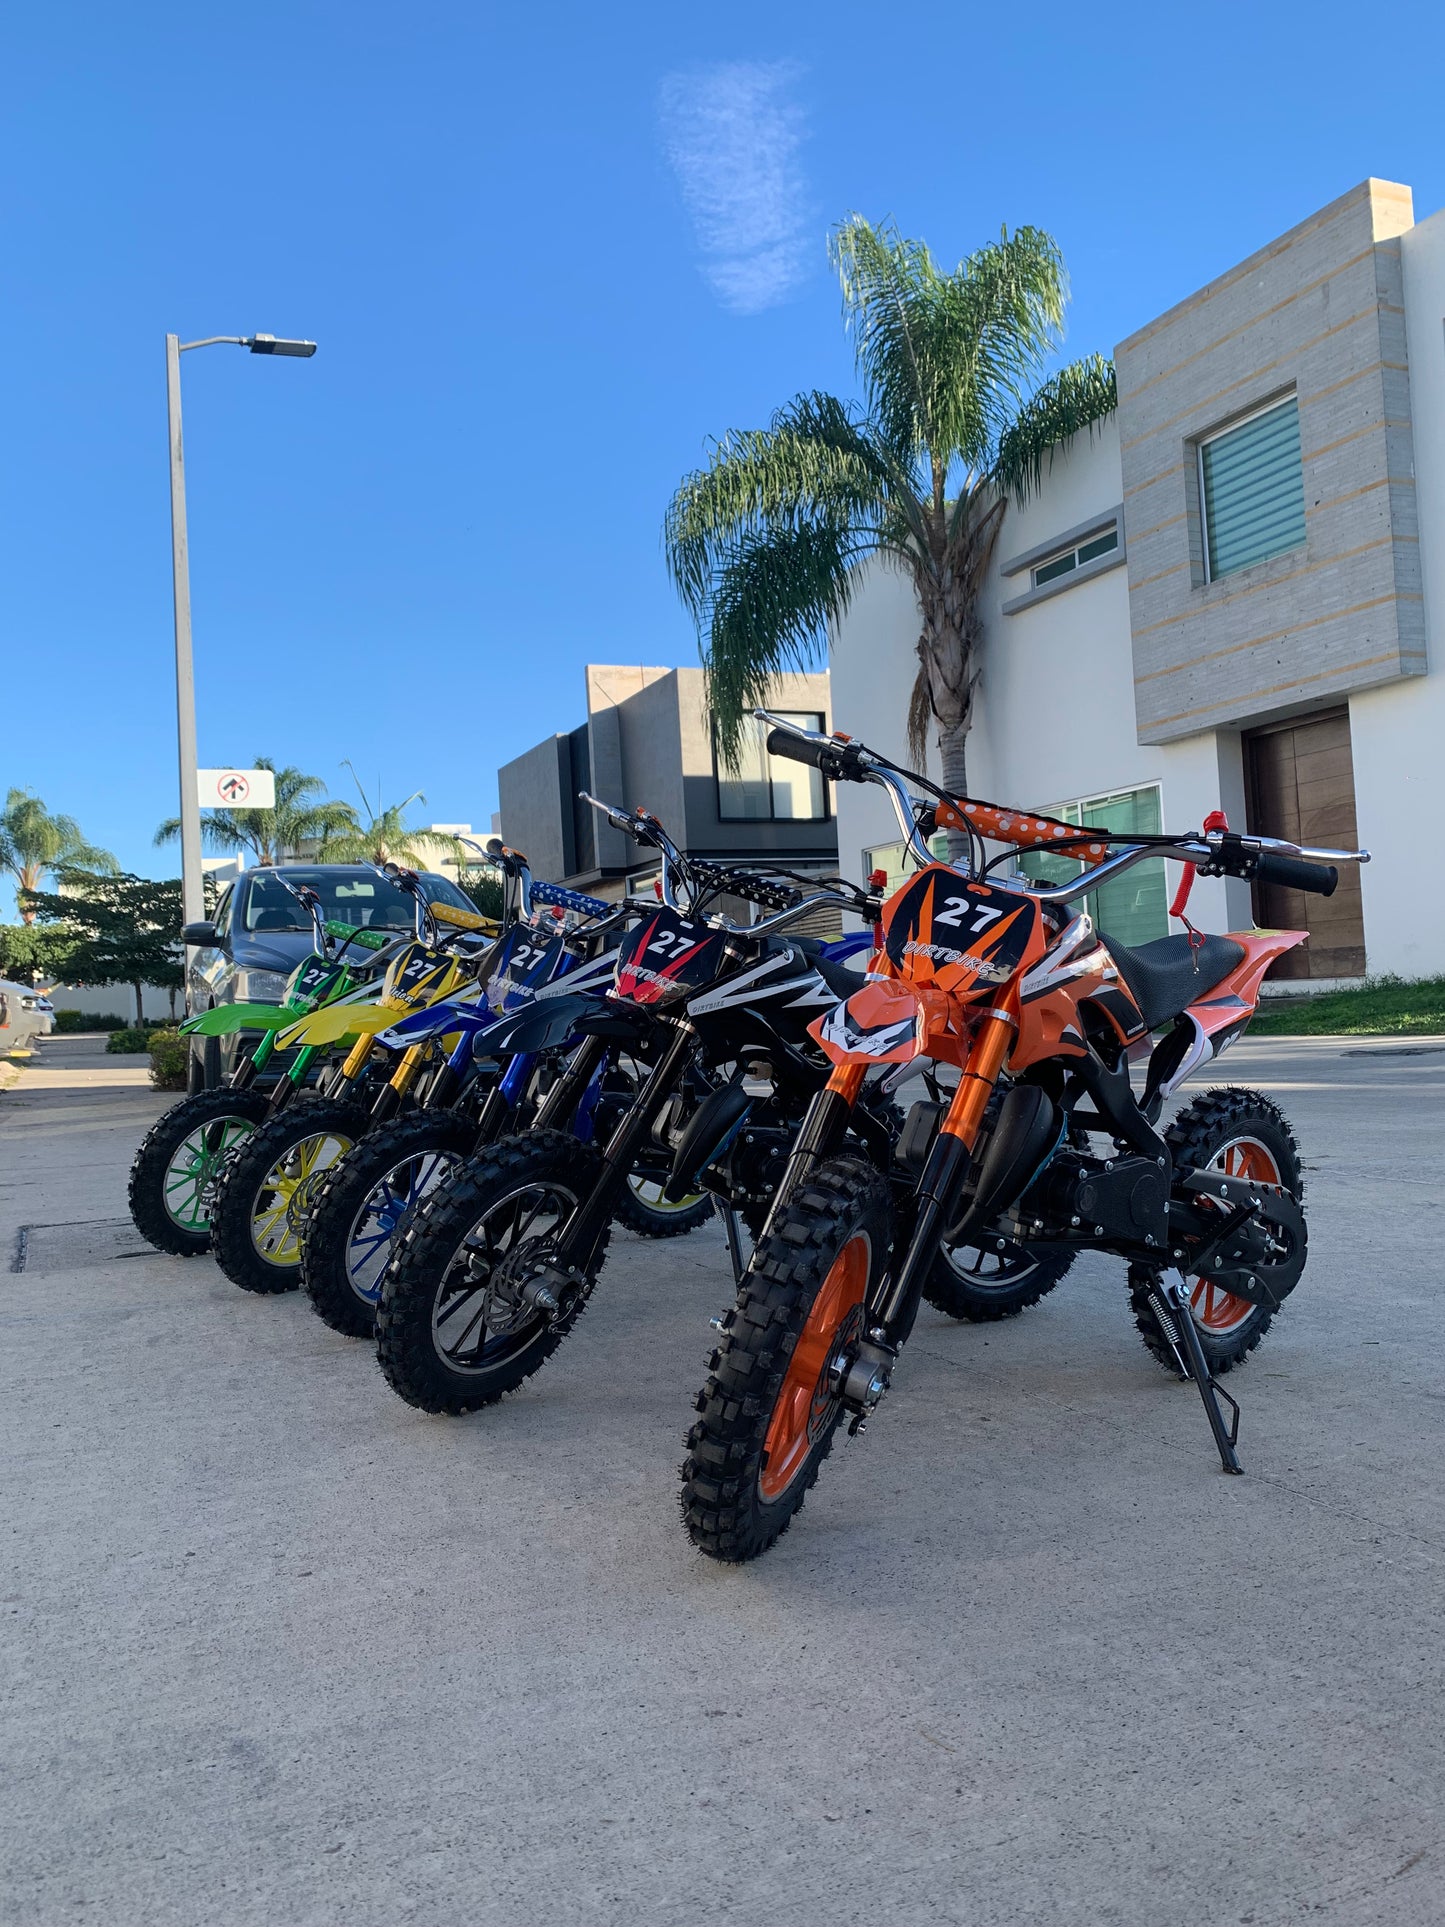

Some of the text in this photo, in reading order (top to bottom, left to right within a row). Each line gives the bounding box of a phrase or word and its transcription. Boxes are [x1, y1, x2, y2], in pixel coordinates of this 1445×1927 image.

[934, 896, 1003, 933] 27
[509, 944, 547, 971] 27
[647, 930, 696, 959] 27
[902, 940, 996, 976] DIRTBIKE
[302, 968, 330, 986] 27
[404, 958, 437, 980] 27
[621, 963, 679, 991] DIRTBIKE
